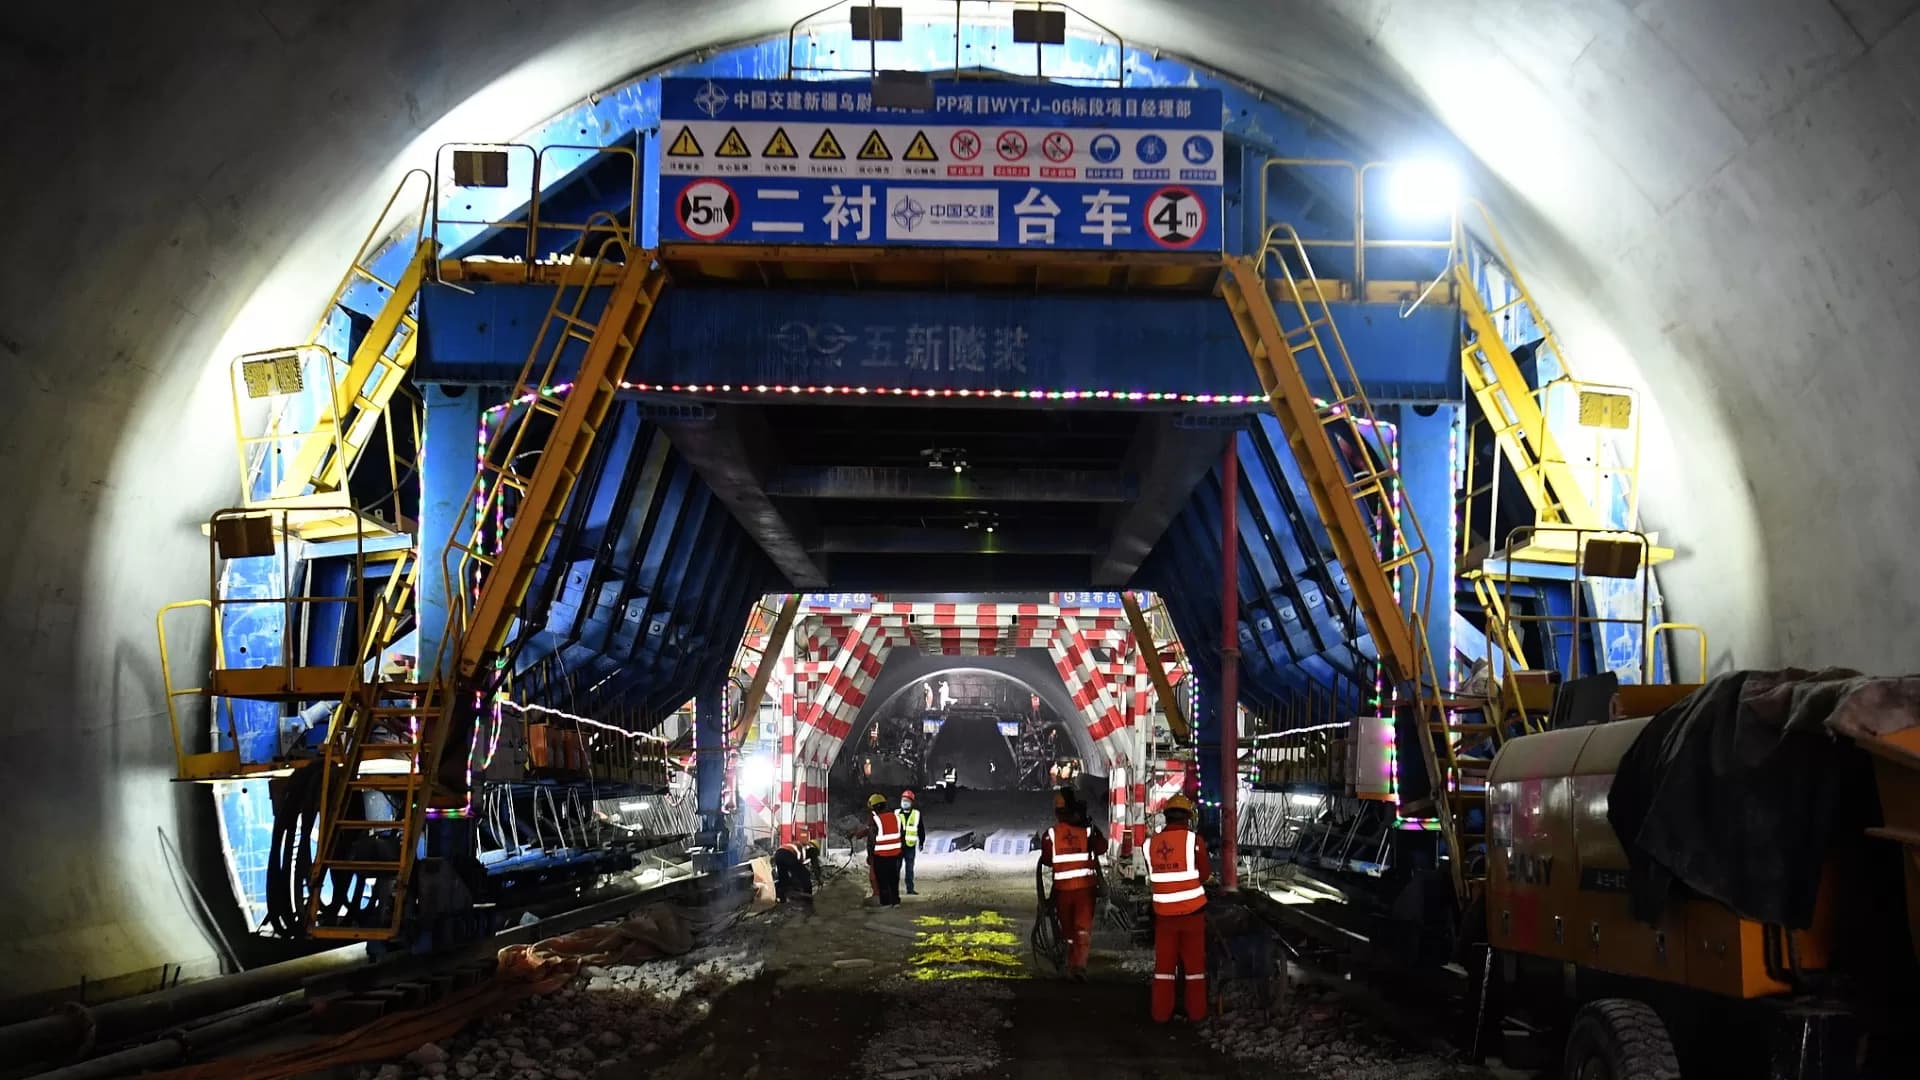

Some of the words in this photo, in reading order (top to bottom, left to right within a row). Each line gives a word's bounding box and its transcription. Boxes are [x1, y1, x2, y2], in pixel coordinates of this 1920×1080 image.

[692, 195, 723, 225] 5m
[751, 185, 876, 242] 二衬
[1013, 188, 1132, 246] 台车
[930, 203, 994, 218] 中国交建
[1153, 201, 1198, 232] 4m
